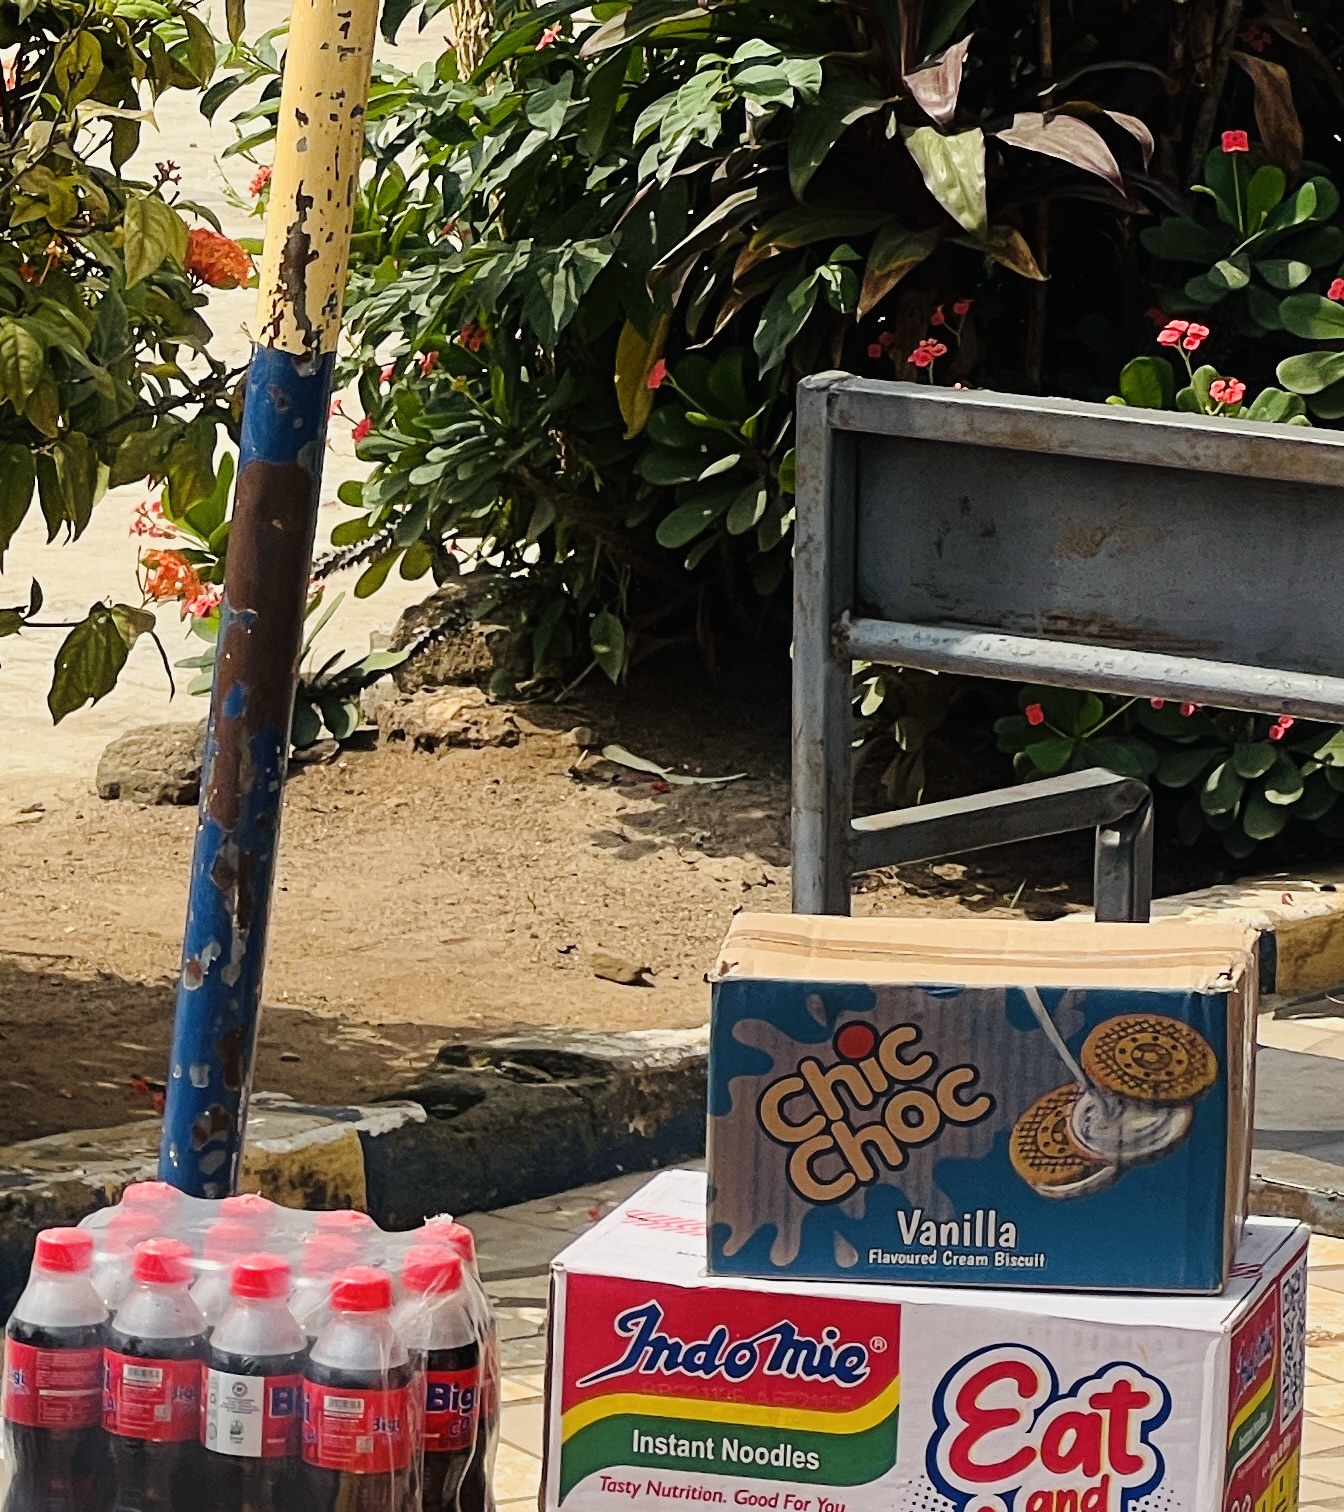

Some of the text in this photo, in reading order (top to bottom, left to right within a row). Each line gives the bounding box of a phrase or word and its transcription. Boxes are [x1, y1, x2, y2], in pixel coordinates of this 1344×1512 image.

[758, 1022, 936, 1144] Chic
[788, 1066, 993, 1203] Choc
[897, 1209, 1017, 1247] Vanilla
[868, 1249, 1046, 1268] Flavoured Cream Biscuit
[426, 1381, 480, 1417] Big
[948, 1360, 1151, 1484] Eat
[632, 1430, 820, 1470] Instant Noodles
[600, 1475, 642, 1500] Tasty
[646, 1480, 727, 1504] Nutrition.
[734, 1489, 778, 1509] Good
[783, 1494, 811, 1512] For
